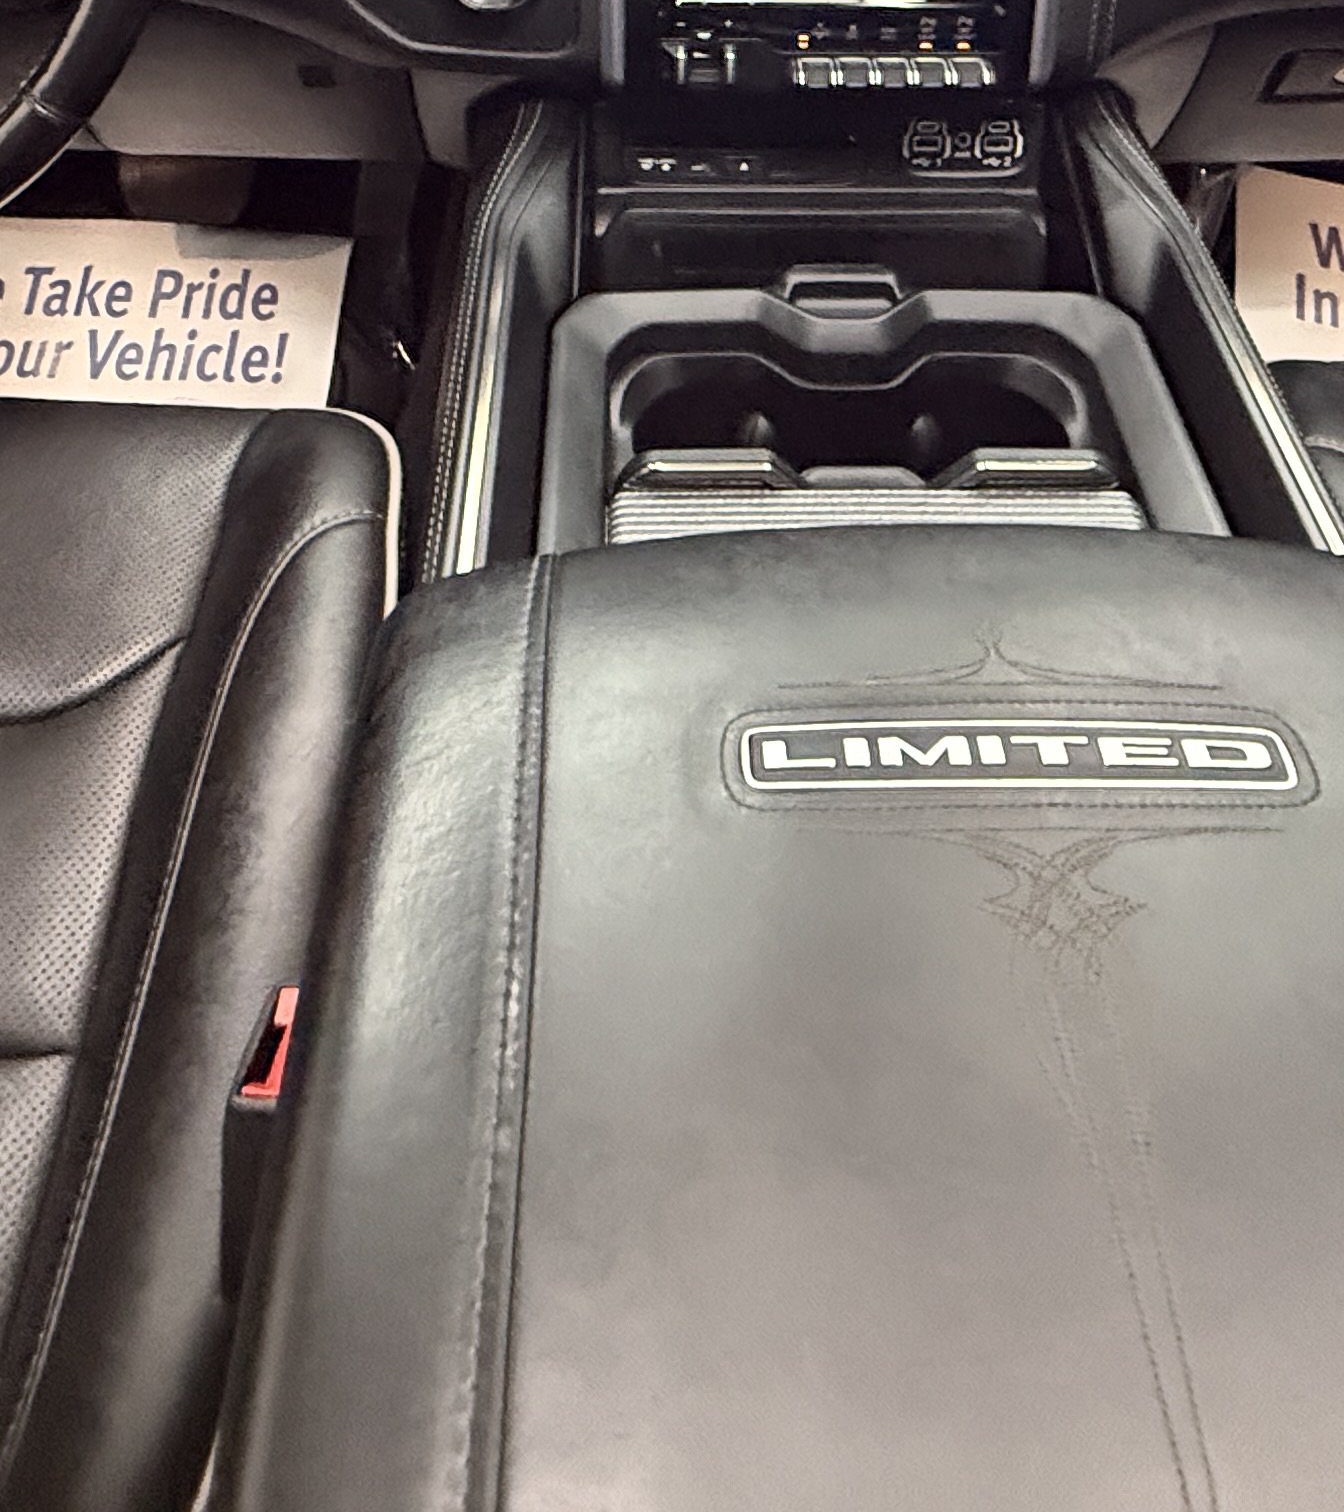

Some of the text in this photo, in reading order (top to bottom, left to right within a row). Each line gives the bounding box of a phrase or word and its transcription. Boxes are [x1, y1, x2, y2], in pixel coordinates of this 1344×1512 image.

[25, 265, 133, 319] Take
[148, 267, 280, 322] Pride
[1295, 273, 1341, 329] In
[87, 328, 289, 386] Vehicle!
[762, 735, 1273, 770] LIMITED
